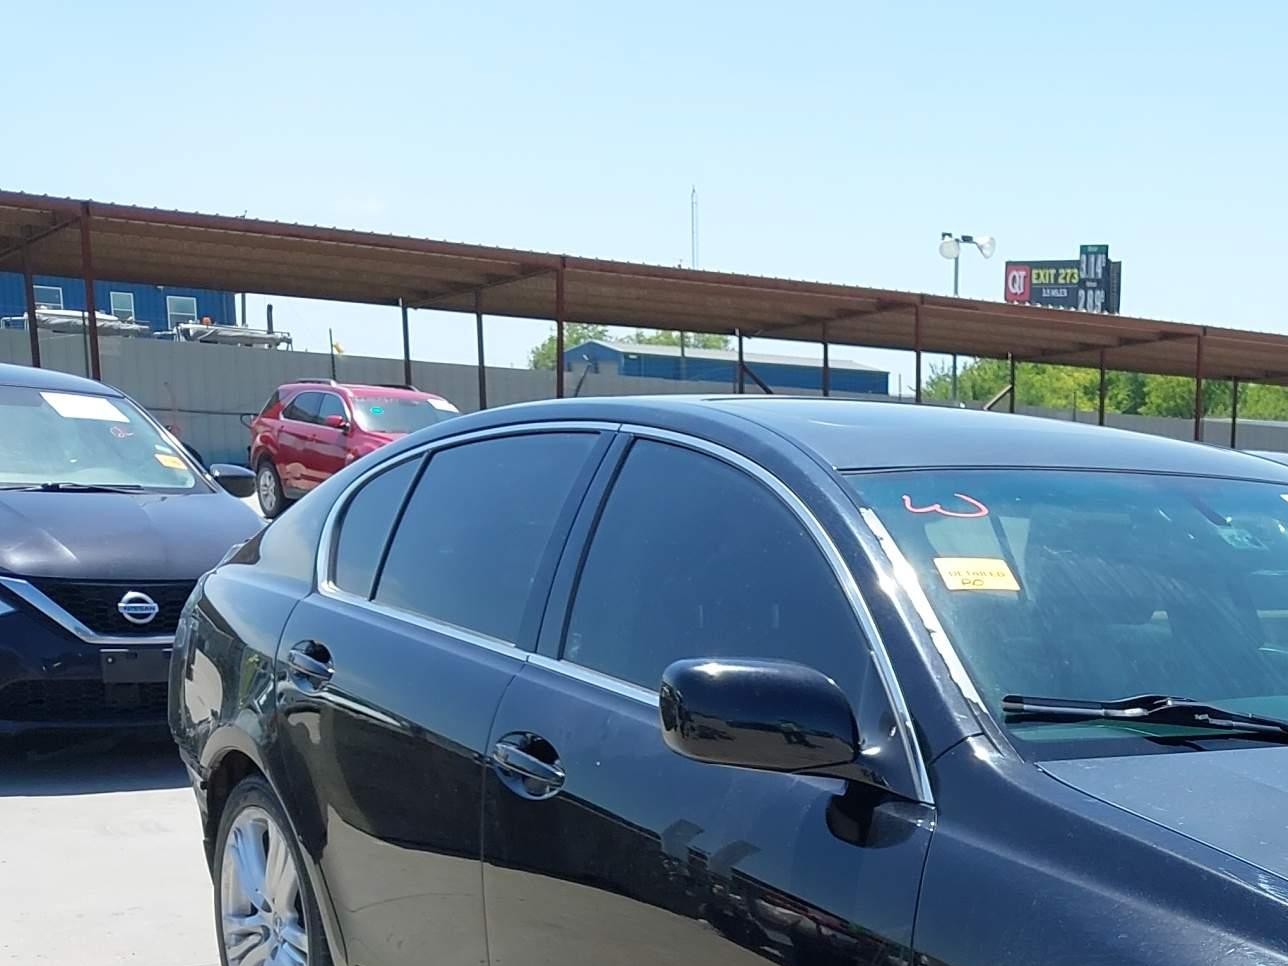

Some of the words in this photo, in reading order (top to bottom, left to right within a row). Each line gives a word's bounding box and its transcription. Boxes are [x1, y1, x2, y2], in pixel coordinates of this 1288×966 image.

[1008, 270, 1026, 295] QT
[1031, 268, 1056, 284] EXIT
[1058, 268, 1079, 284] 273
